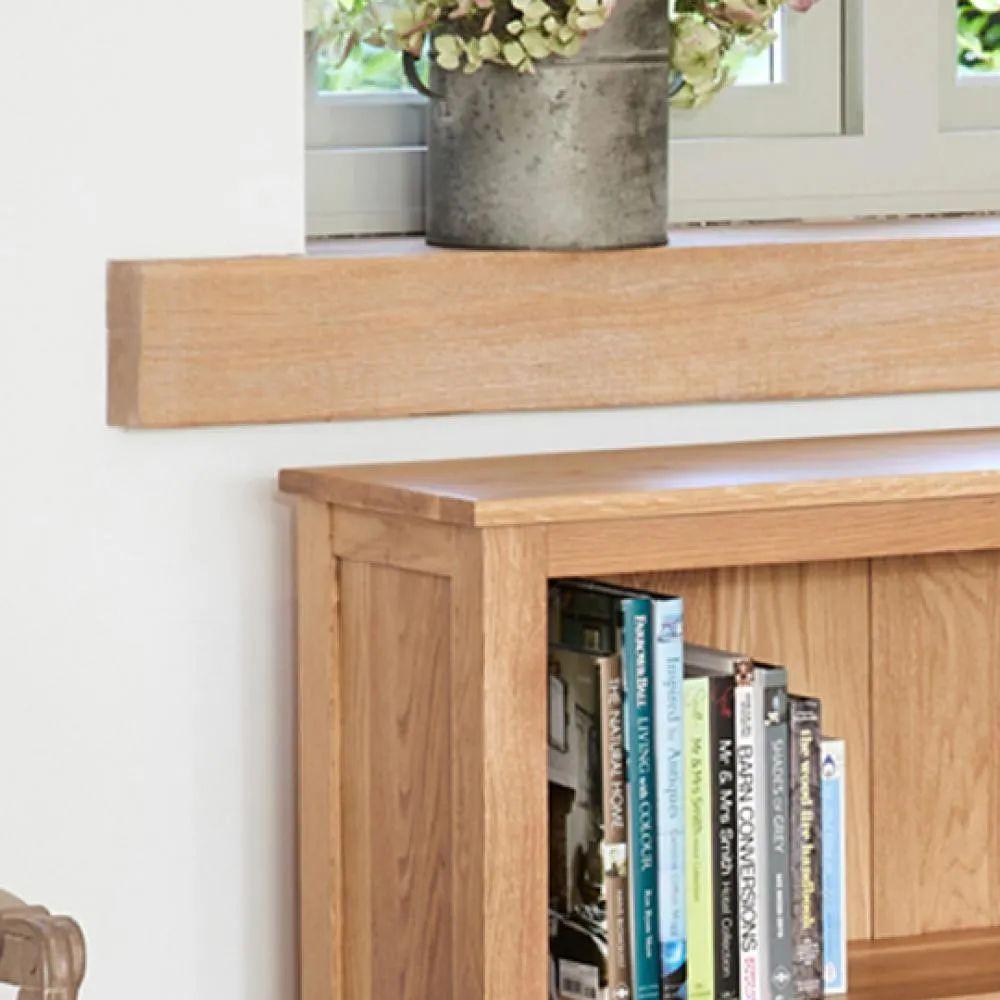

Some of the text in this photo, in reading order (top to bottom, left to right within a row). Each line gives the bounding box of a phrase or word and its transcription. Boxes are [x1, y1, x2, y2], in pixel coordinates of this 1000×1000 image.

[663, 656, 681, 721] Inspired
[608, 677, 625, 830] THE NATURAL HOME
[636, 717, 651, 773] LIVING
[719, 740, 734, 765] Mr
[772, 739, 785, 792] SHADES
[799, 729, 814, 757] the
[719, 771, 734, 785] &
[737, 745, 755, 803] BARN
[799, 761, 815, 806] wood
[719, 790, 735, 824] Mrs
[638, 801, 653, 871] COLOUR
[719, 828, 736, 875] Smith
[772, 815, 787, 854] GREY
[738, 806, 757, 953] CONVERSIONS
[799, 845, 816, 929] handbook
